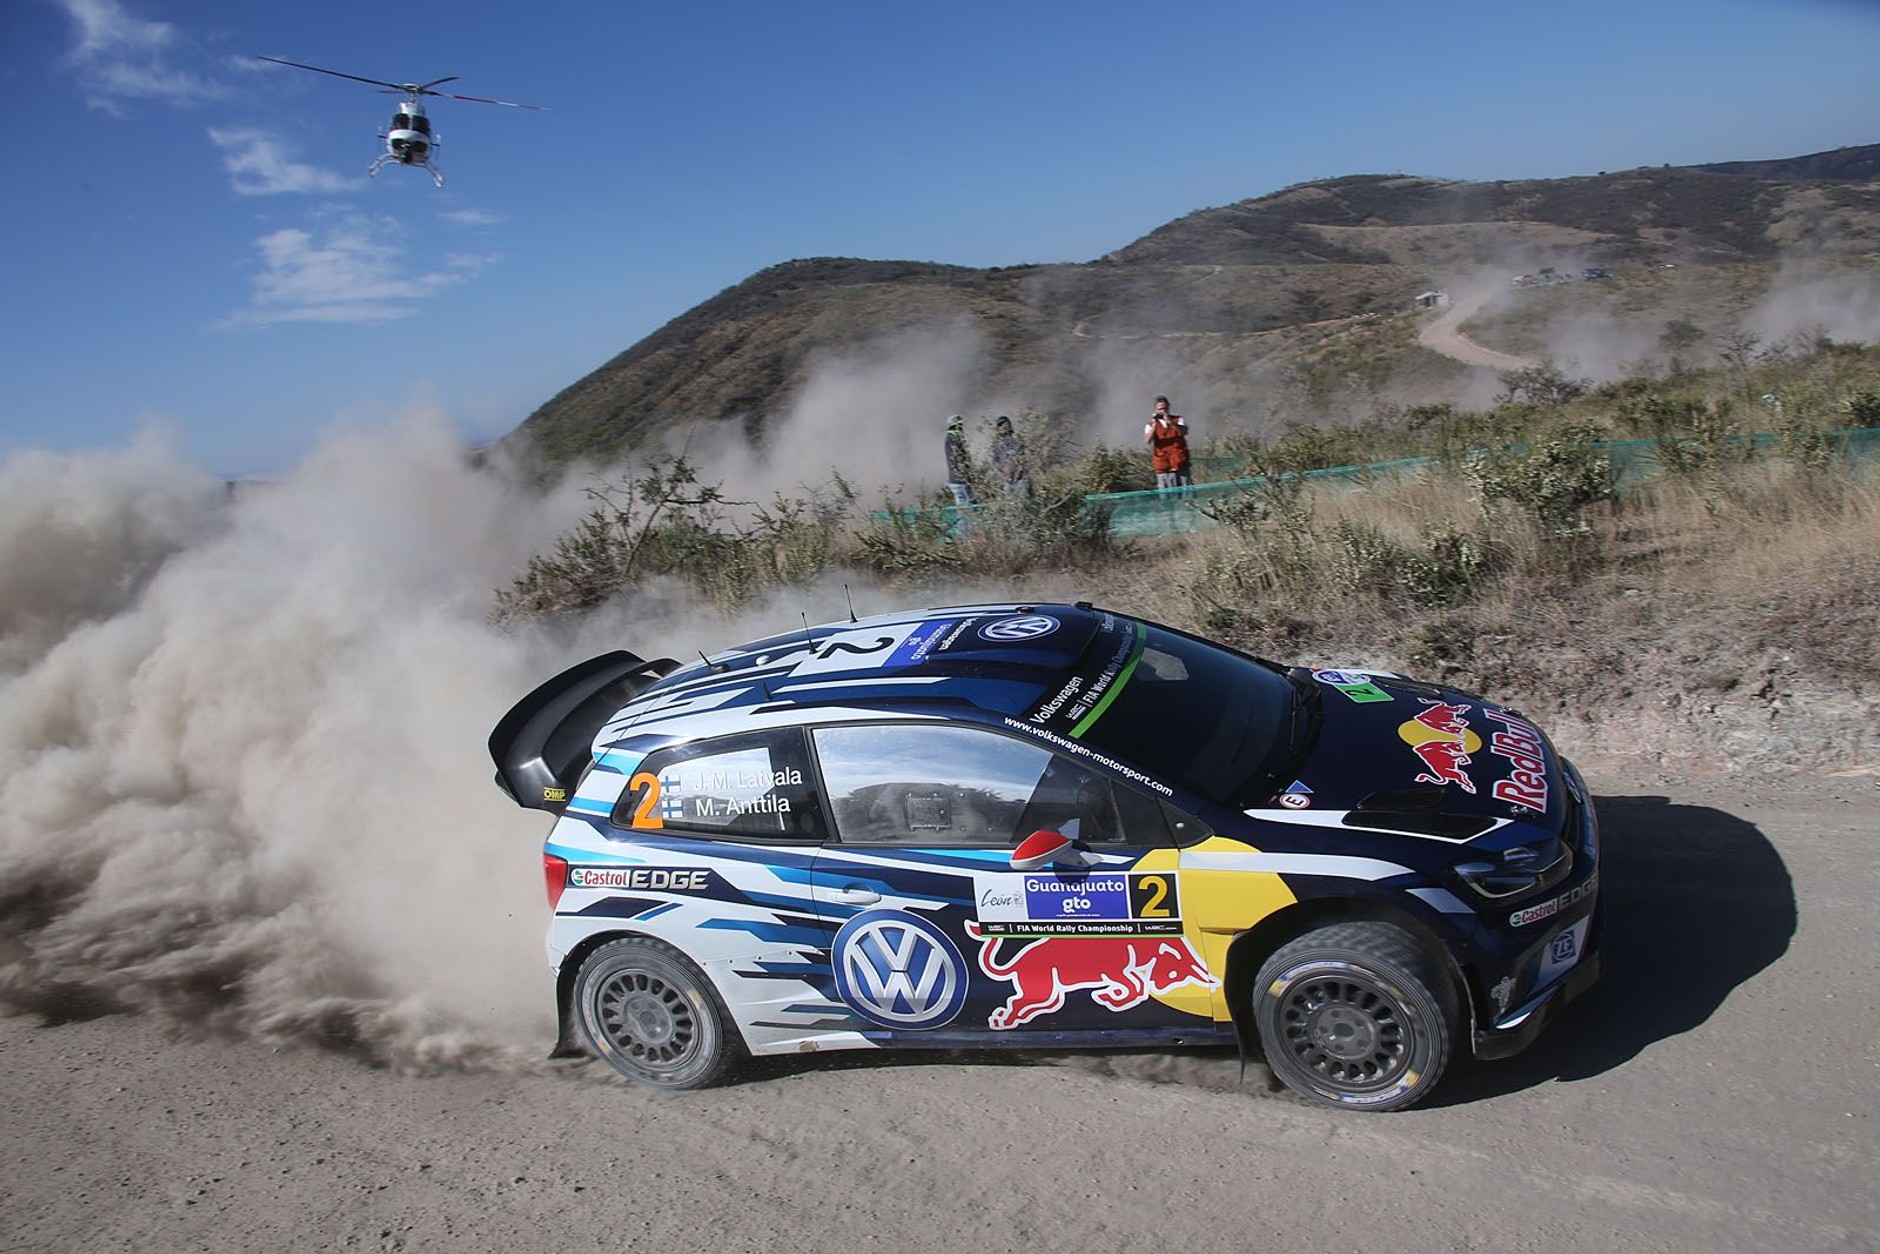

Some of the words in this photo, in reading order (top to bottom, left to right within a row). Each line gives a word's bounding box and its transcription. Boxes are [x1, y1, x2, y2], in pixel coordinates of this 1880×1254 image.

[1029, 676, 1084, 724] Volkswagen
[1082, 690, 1100, 704] FIA
[1004, 716, 1173, 798] www.volkswagen-motorsport.com
[543, 788, 566, 800] OMP
[629, 772, 664, 829] 2
[695, 798, 720, 817] M.
[726, 794, 791, 816] Anttila
[584, 870, 628, 886] Castrol
[631, 870, 712, 890] EDGE
[1026, 879, 1125, 896] Guanajuato
[1062, 896, 1092, 913] gto
[1138, 875, 1170, 917] 2
[1521, 901, 1557, 923] Castrol
[1032, 924, 1054, 932] World
[1056, 925, 1076, 933] Rally
[1077, 924, 1134, 934] Championship
